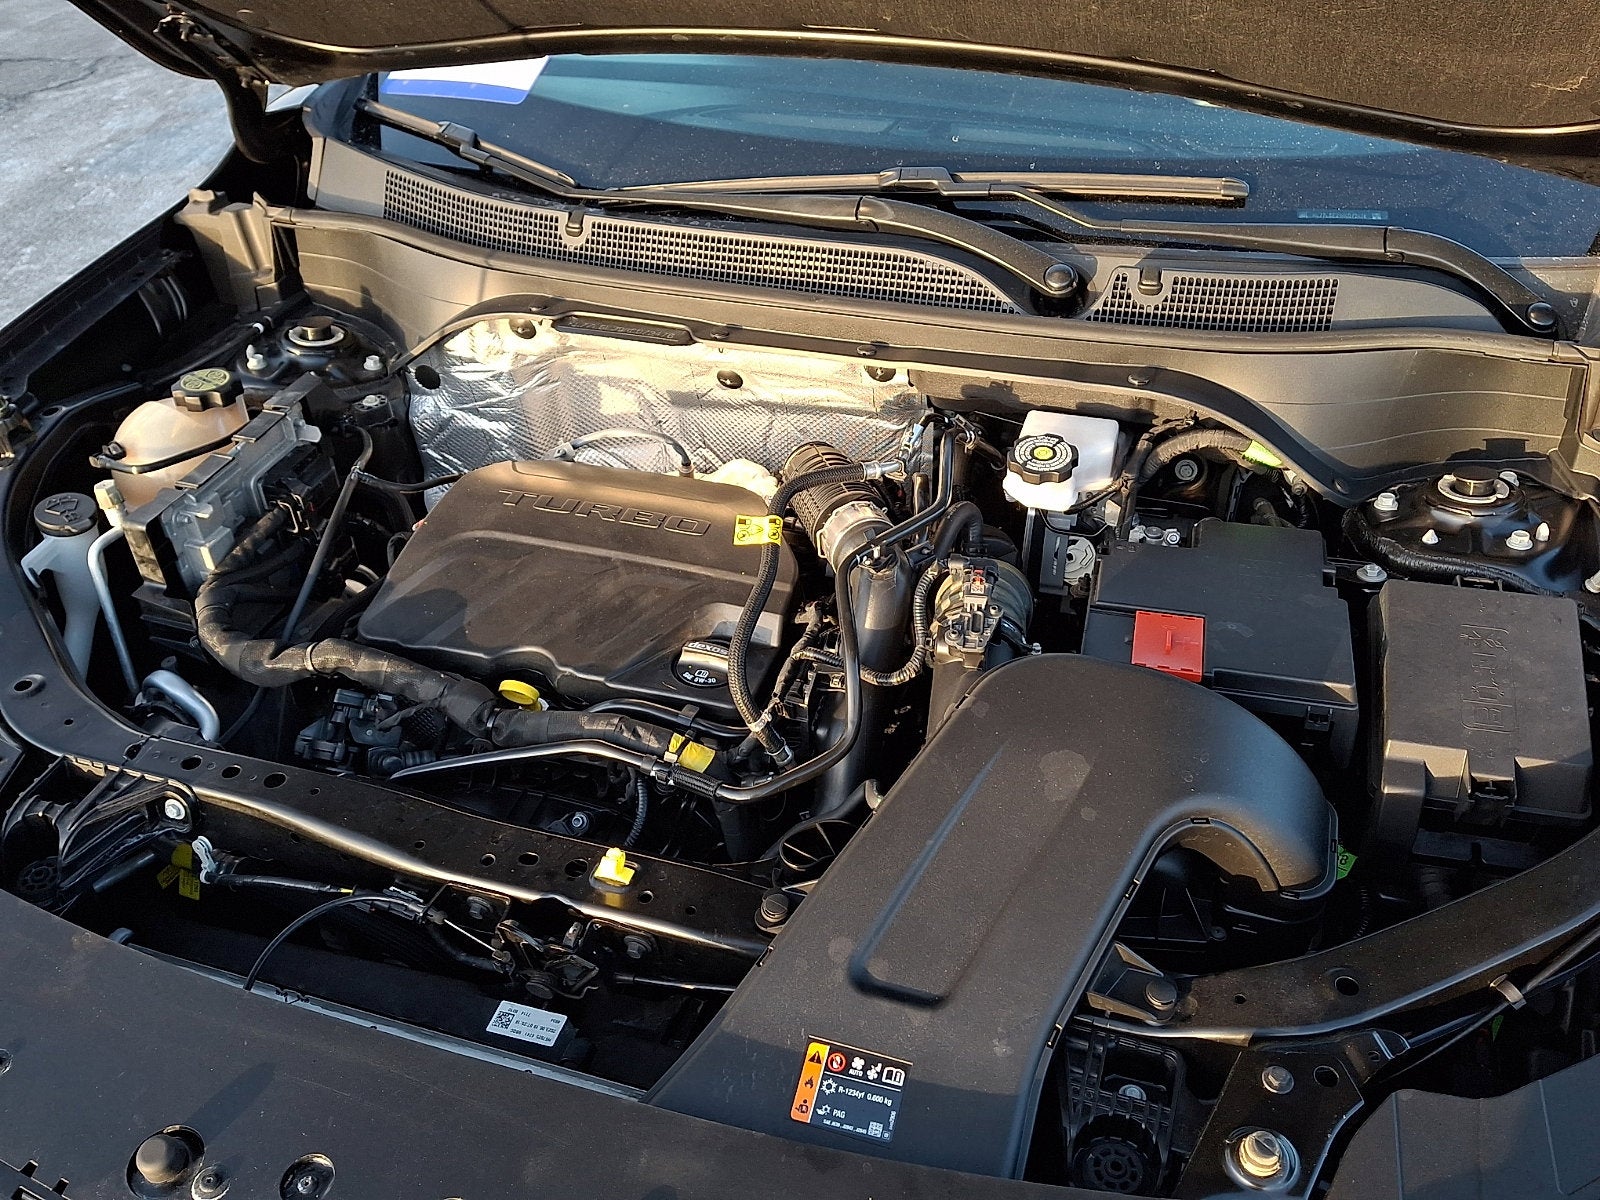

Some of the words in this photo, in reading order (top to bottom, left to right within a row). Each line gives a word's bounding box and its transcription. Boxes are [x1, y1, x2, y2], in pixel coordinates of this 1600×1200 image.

[499, 488, 712, 537] TURBO
[688, 641, 729, 655] dexos
[848, 1068, 863, 1076] AUTO
[838, 1085, 865, 1100] R-1234yf
[884, 1097, 892, 1106] kg
[833, 1109, 846, 1119] PAG
